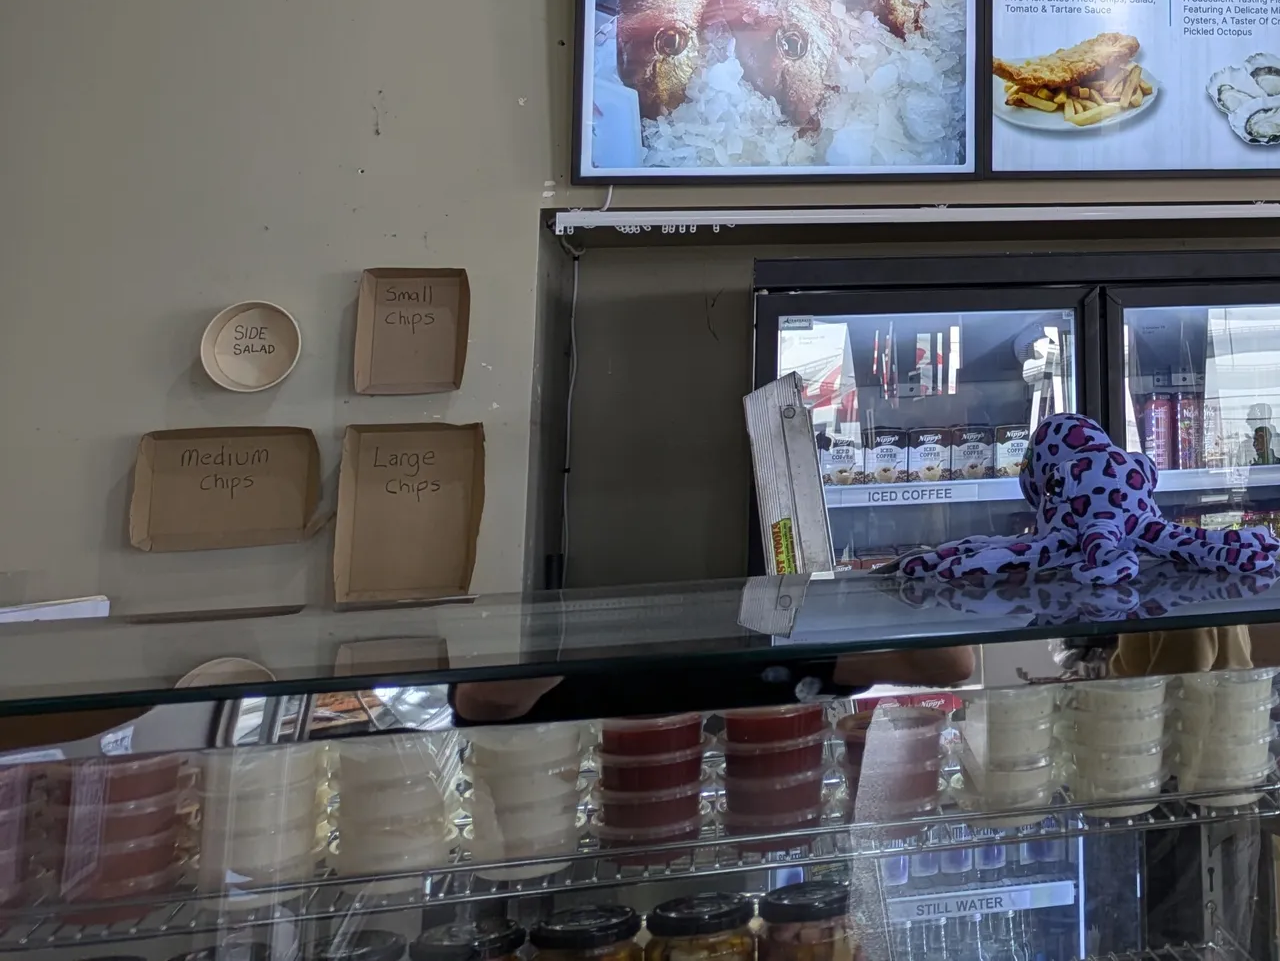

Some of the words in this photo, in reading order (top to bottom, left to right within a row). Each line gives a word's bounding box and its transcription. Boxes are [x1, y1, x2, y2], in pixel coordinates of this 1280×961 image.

[385, 285, 432, 305] Small
[234, 325, 268, 341] SIDE
[233, 343, 276, 356] SALAD
[374, 446, 435, 477] Large
[868, 491, 898, 502] ICED
[902, 488, 952, 501] COFFEE
[916, 902, 952, 916] STILL
[955, 896, 1003, 912] WATER
